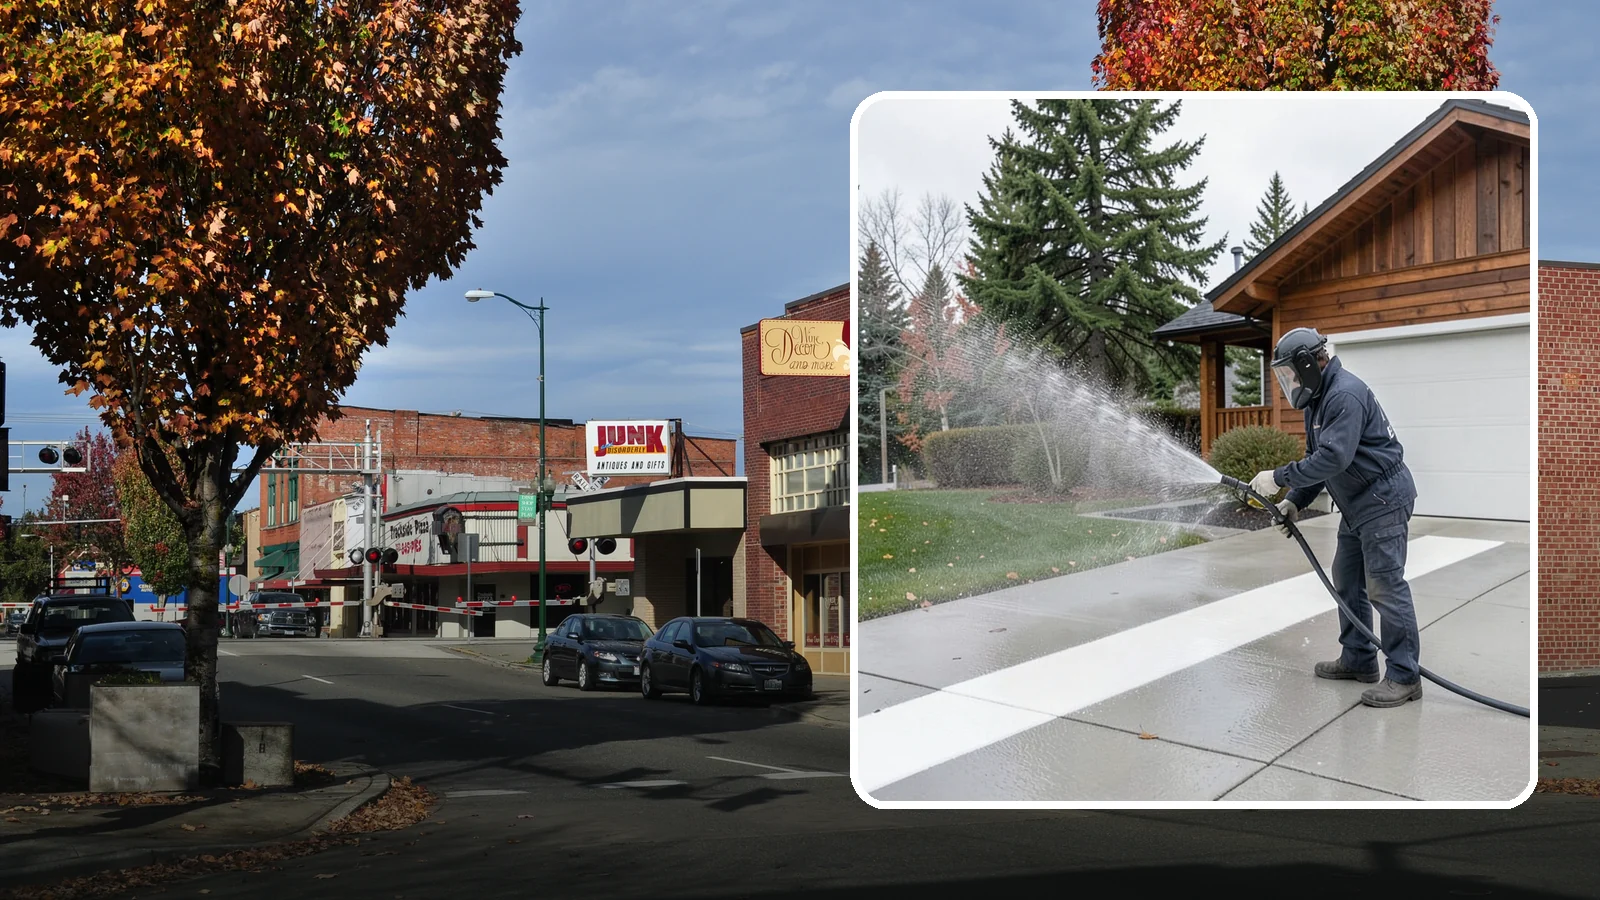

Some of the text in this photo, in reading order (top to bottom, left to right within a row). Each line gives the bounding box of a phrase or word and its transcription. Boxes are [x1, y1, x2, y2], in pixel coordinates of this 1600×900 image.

[595, 425, 665, 457] JUNK
[607, 446, 646, 454] DISORDERLY
[597, 460, 665, 470] ANTIQUES AND GIFTS
[414, 519, 429, 535] Pizza
